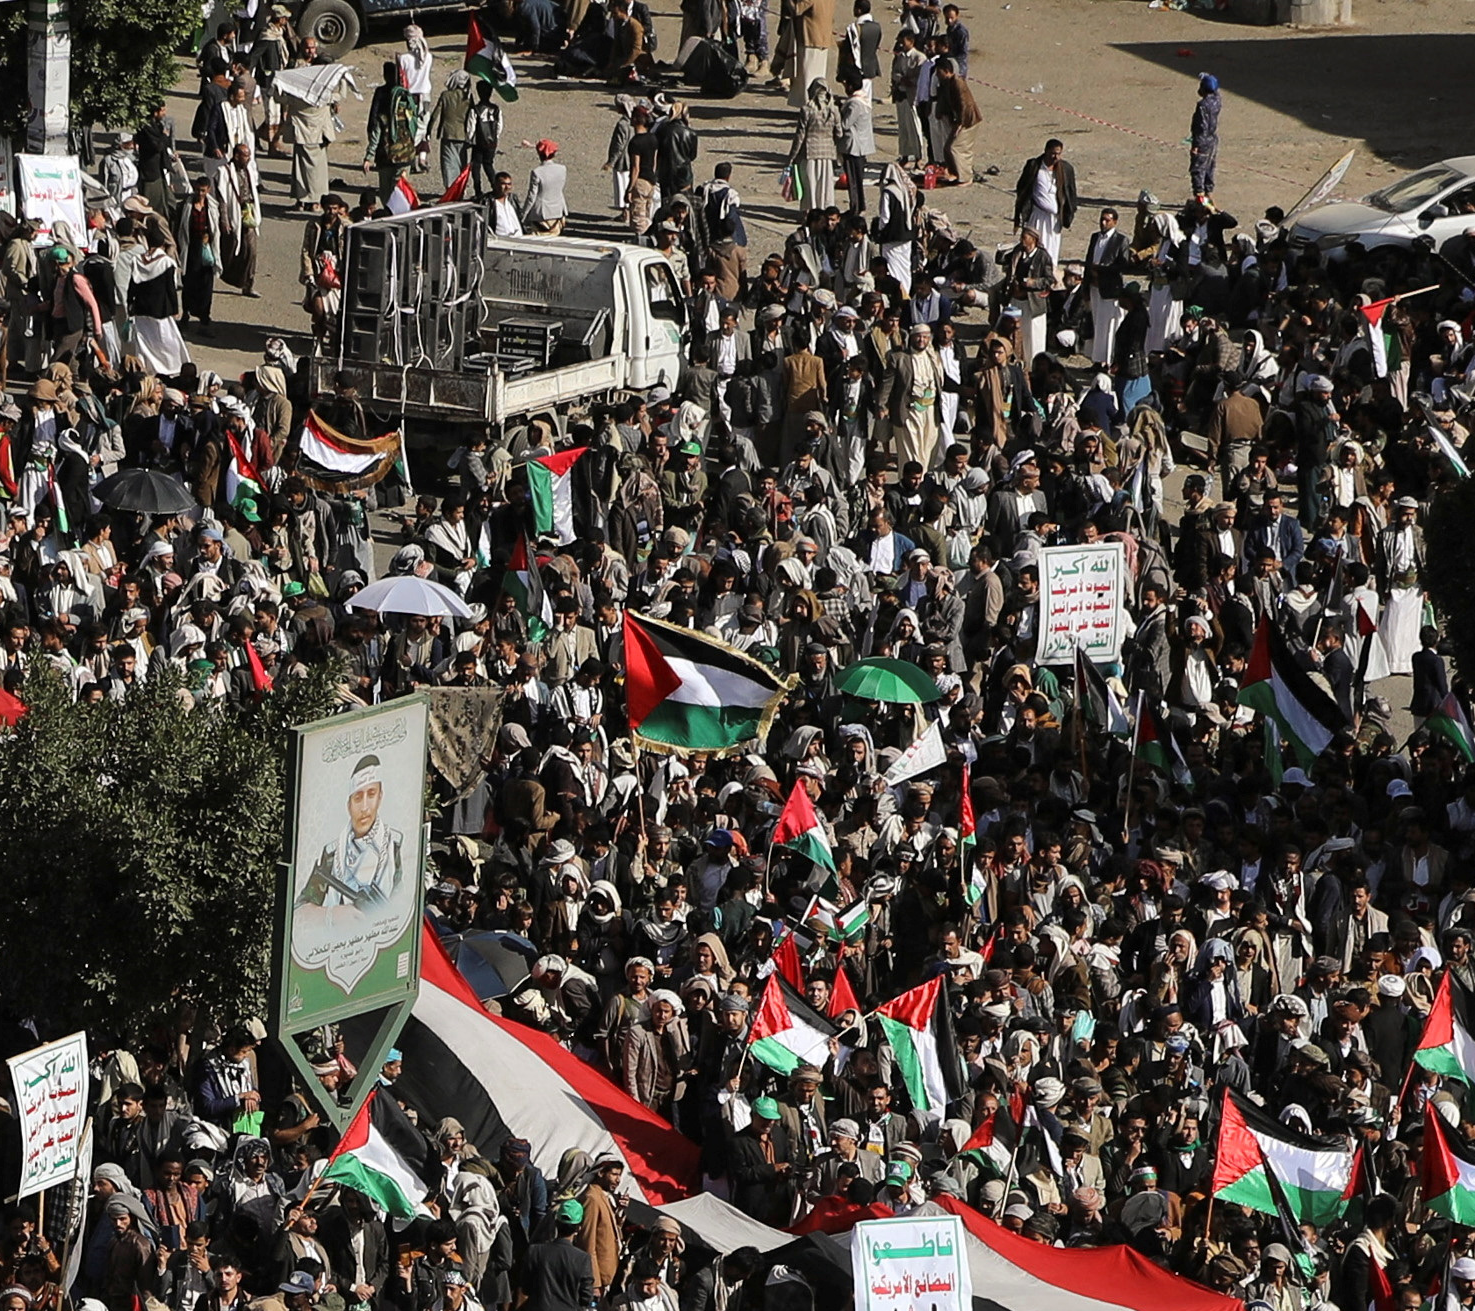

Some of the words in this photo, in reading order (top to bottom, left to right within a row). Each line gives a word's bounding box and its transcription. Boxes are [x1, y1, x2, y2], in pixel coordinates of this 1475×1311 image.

[866, 1231, 954, 1265] قاطعوا
[870, 1271, 913, 1299] الأمريكية
[914, 1271, 955, 1298] البضائع
